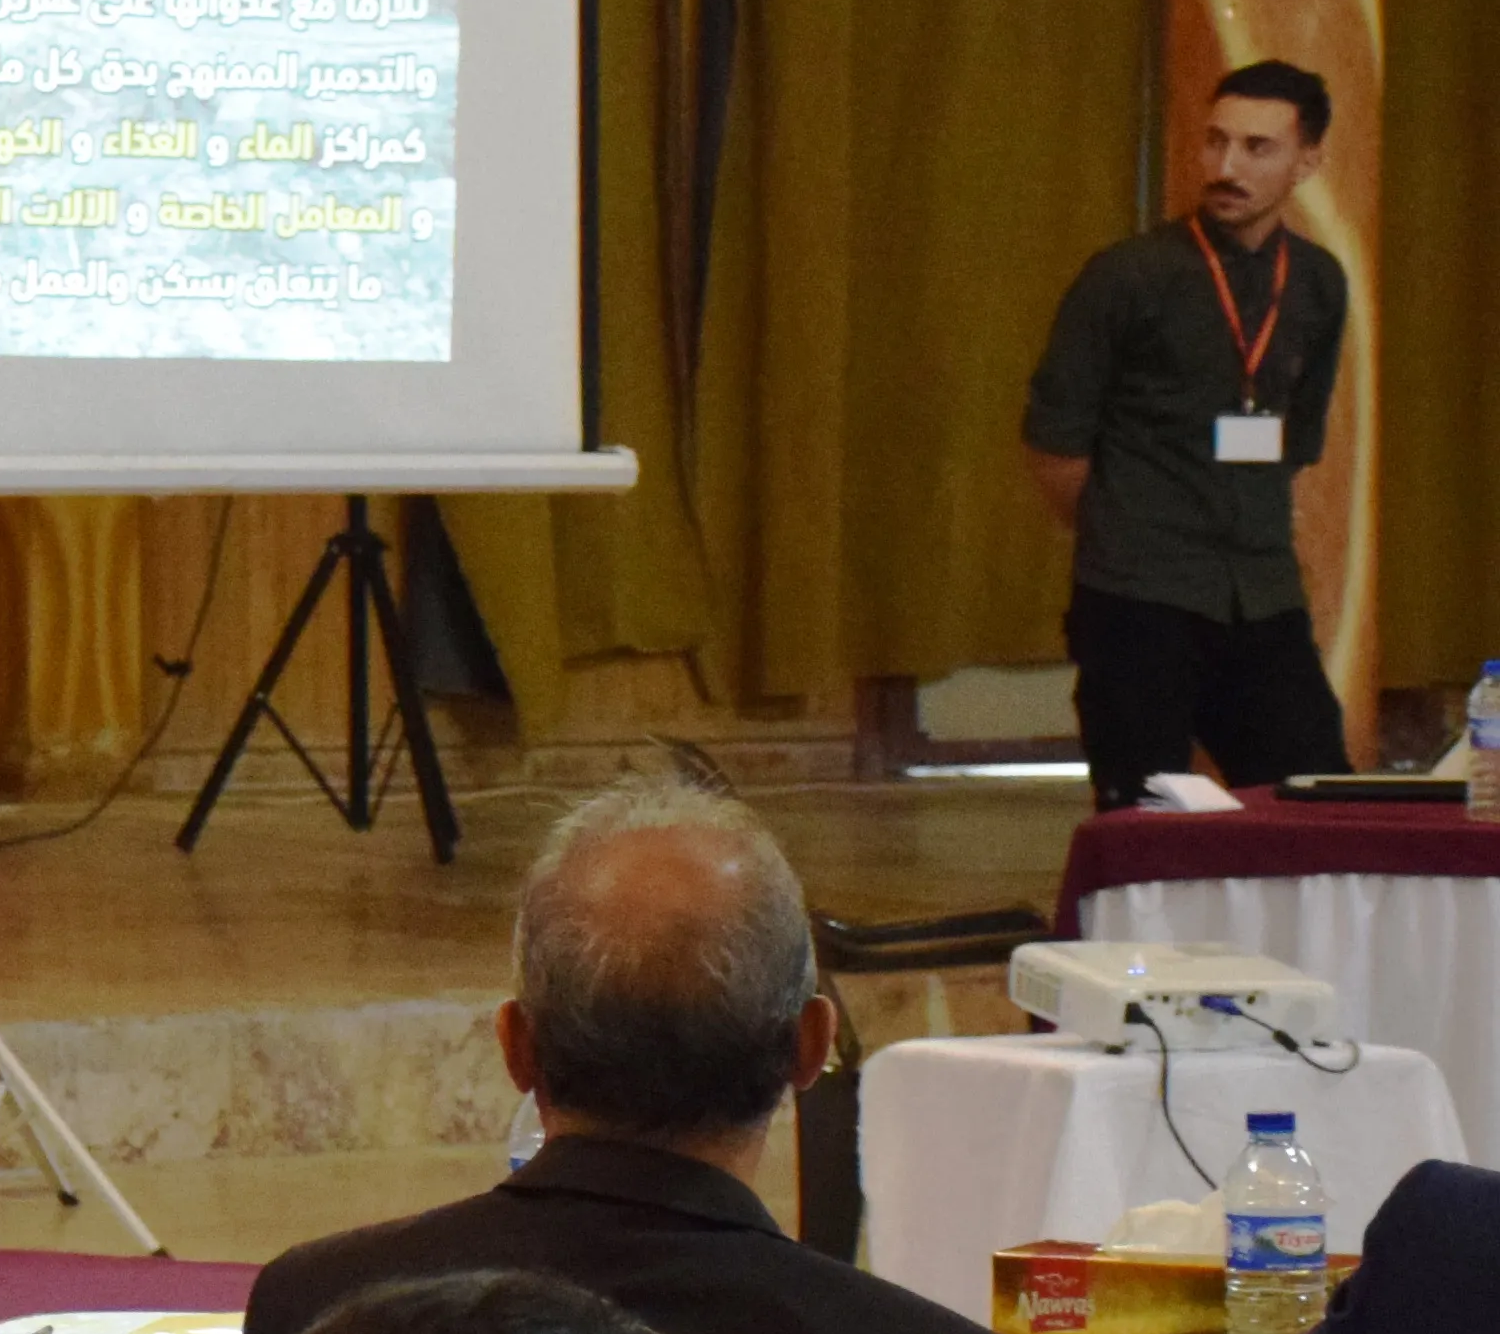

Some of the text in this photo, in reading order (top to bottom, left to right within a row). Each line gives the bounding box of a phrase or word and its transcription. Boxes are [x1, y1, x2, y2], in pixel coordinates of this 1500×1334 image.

[289, 0, 336, 30] مع
[33, 47, 82, 91] كل
[91, 49, 157, 95] بحق
[167, 52, 298, 99] الممنهج
[307, 54, 437, 100] والتدمير
[71, 131, 92, 162] و
[103, 119, 197, 159] الغذاء
[206, 135, 228, 165] و
[237, 123, 314, 160] الماء
[319, 124, 426, 168] كمراكز
[126, 201, 149, 235] و
[159, 192, 265, 229] الخاصة
[275, 195, 402, 238] المعامل
[411, 208, 434, 240] و
[9, 259, 124, 303] والعمل
[137, 261, 236, 308] بسكن
[243, 264, 338, 308] يتعلق
[348, 264, 381, 300] ما
